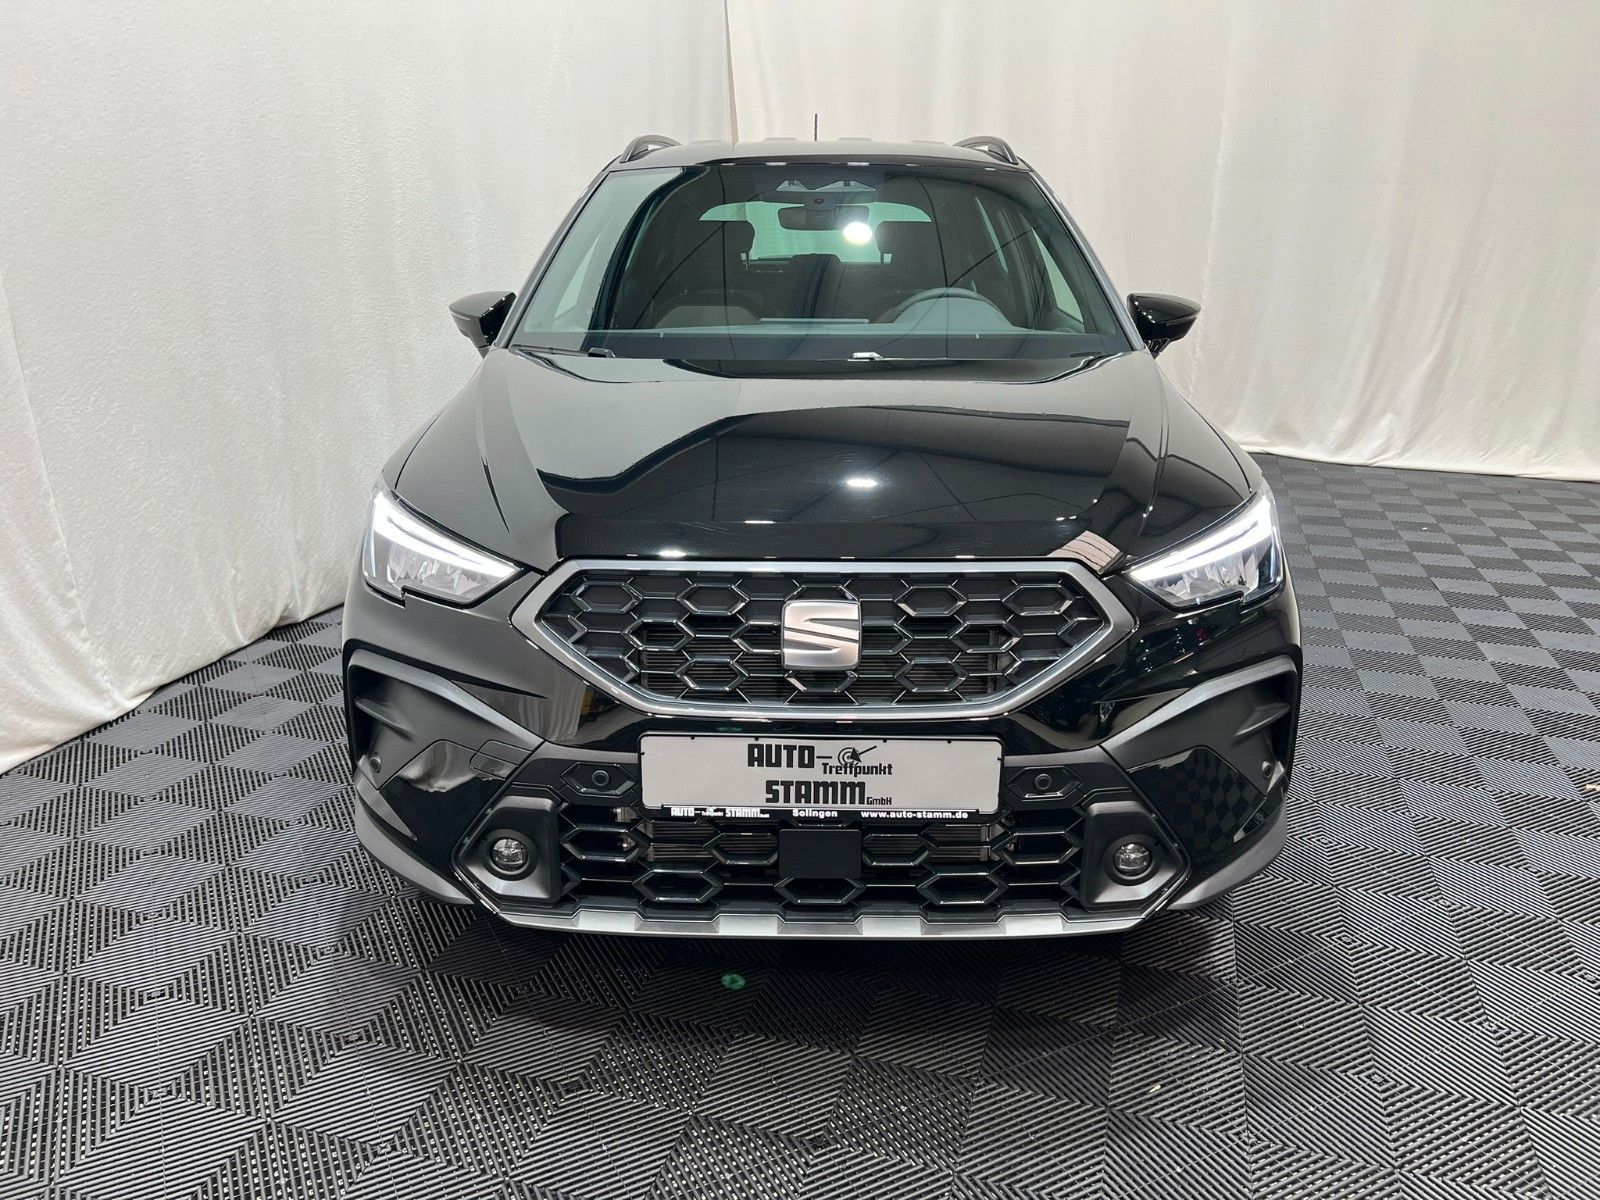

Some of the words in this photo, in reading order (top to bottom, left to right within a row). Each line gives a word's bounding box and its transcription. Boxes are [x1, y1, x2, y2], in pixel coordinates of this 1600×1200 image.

[821, 763, 893, 778] Treffpunkt
[765, 780, 866, 805] STAMM
[866, 797, 892, 806] GmbH
[792, 809, 838, 819] Solingen
[860, 810, 969, 820] www.auto-stamm.de
